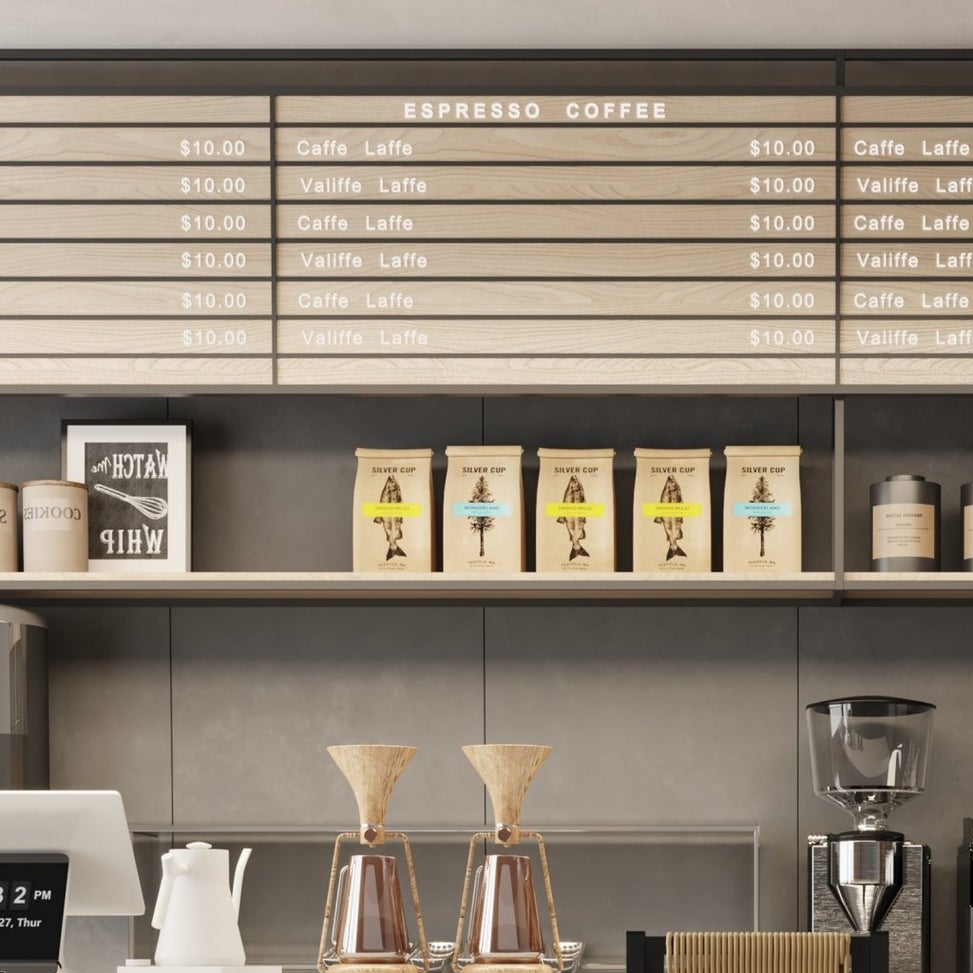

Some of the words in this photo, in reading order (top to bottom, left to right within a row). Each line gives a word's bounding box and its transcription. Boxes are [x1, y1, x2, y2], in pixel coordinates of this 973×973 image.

[404, 102, 540, 119] ESPRESSO
[566, 102, 666, 119] COFFEE
[180, 139, 245, 156] $10.00
[297, 140, 348, 156] Caffe
[365, 140, 413, 156] Laffe
[750, 139, 815, 157] $10.00
[854, 140, 905, 156] Caffe
[922, 140, 970, 156] Laffe
[180, 176, 246, 194] $10.00
[300, 177, 362, 193] Valiffe
[379, 177, 427, 193] Laffe
[750, 176, 815, 194] $10.00
[856, 177, 919, 193] Valiffe
[181, 214, 246, 232] $10.00
[297, 215, 348, 231] Caffe
[365, 215, 413, 231] Laffe
[750, 214, 815, 232] $10.00
[854, 215, 905, 231] Caffe
[922, 215, 970, 231] Laffe
[181, 252, 246, 269] $10.00
[301, 252, 363, 268] Valiffe
[380, 252, 427, 268] Laffe
[750, 251, 815, 269] $10.00
[856, 252, 919, 268] Valiffe
[182, 292, 246, 309] $10.00
[298, 292, 349, 309] Caffe
[366, 292, 414, 309] Laffe
[750, 292, 815, 309] $10.00
[854, 292, 905, 309] Caffe
[921, 292, 970, 308] Laffe
[182, 329, 247, 347] $10.00
[301, 330, 363, 346] Valiffe
[380, 330, 428, 345] Laffe
[750, 329, 814, 346] $10.00
[856, 330, 919, 346] Valiffe
[371, 466, 398, 474] SILVER
[400, 466, 416, 474] CUP
[462, 466, 488, 474] SILVER
[490, 466, 507, 474] CUP
[554, 466, 580, 474] SILVER
[582, 466, 599, 474] CUP
[650, 466, 677, 474] SILVER
[679, 466, 696, 474] CUP
[741, 466, 768, 474] SILVER
[770, 466, 786, 474] CUP
[34, 890, 52, 900] PM
[17, 918, 42, 927] Thur
